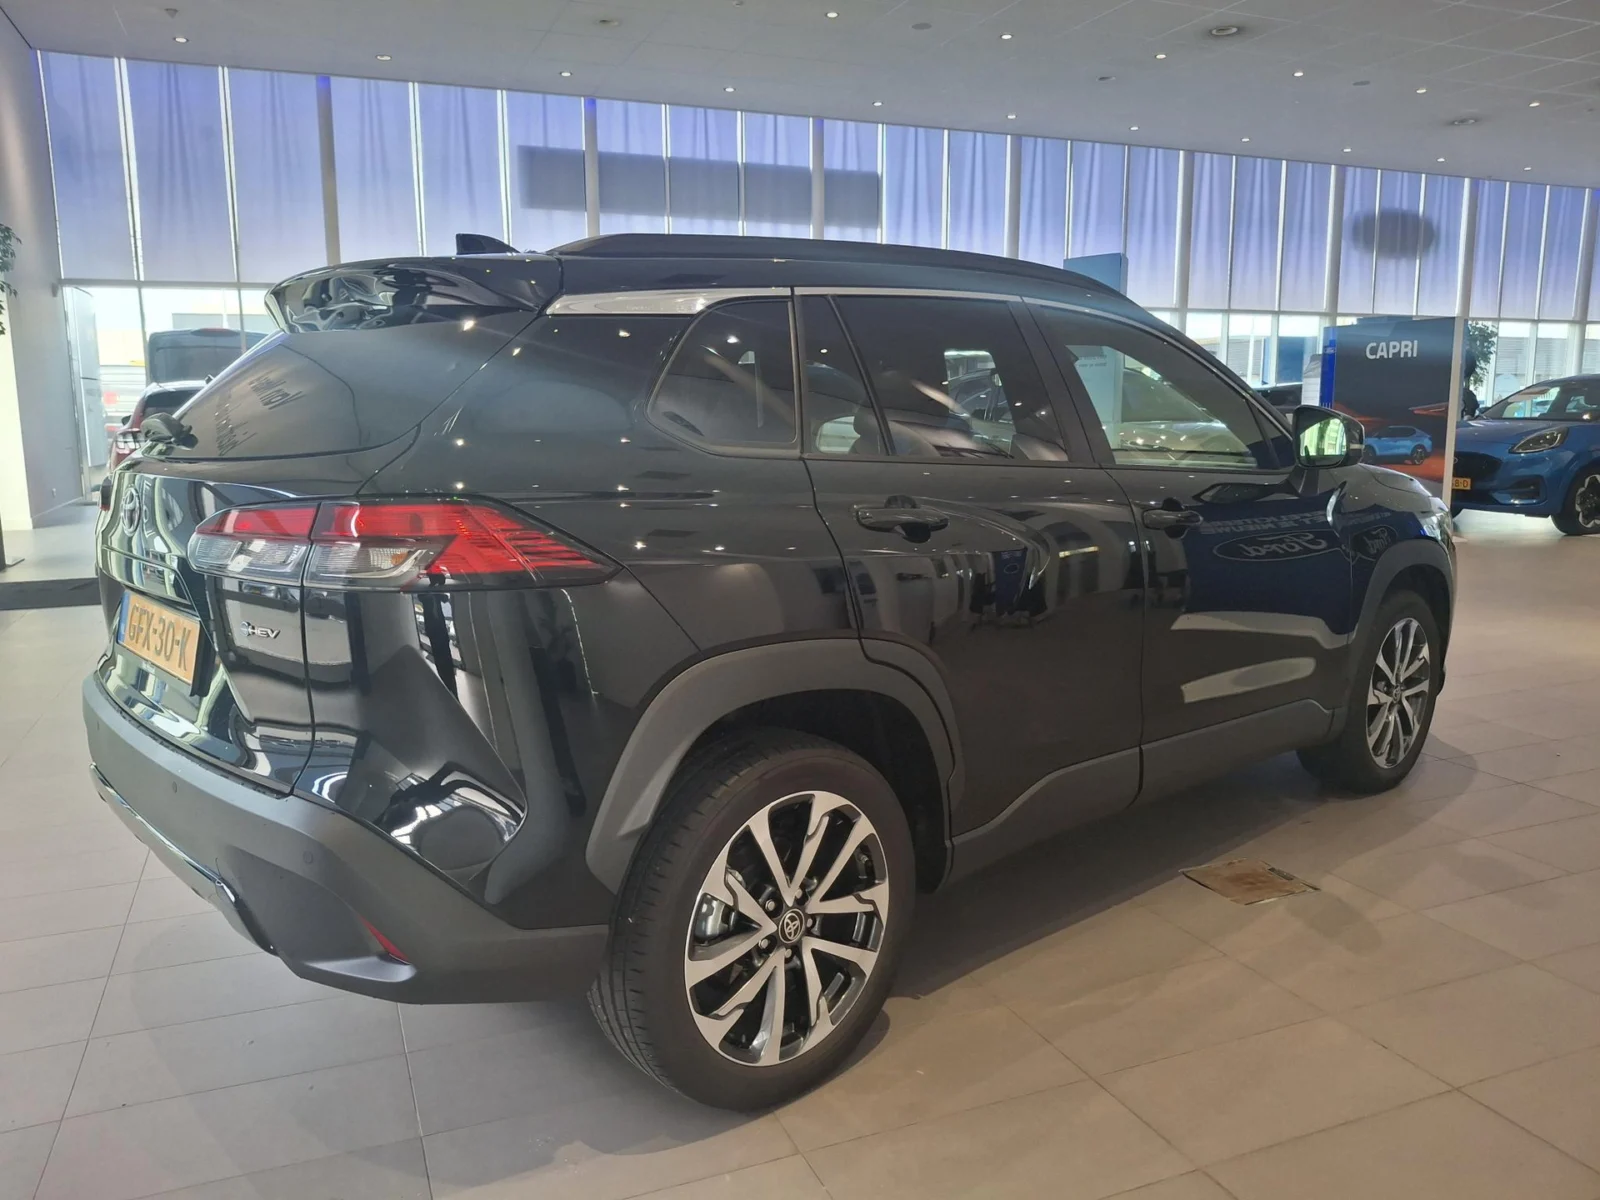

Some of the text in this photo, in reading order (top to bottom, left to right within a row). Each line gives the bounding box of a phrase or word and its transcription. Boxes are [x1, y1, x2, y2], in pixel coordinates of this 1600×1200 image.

[1366, 340, 1418, 359] CAPRI
[129, 605, 190, 672] GFX-30-K
[248, 625, 281, 639] HEV
